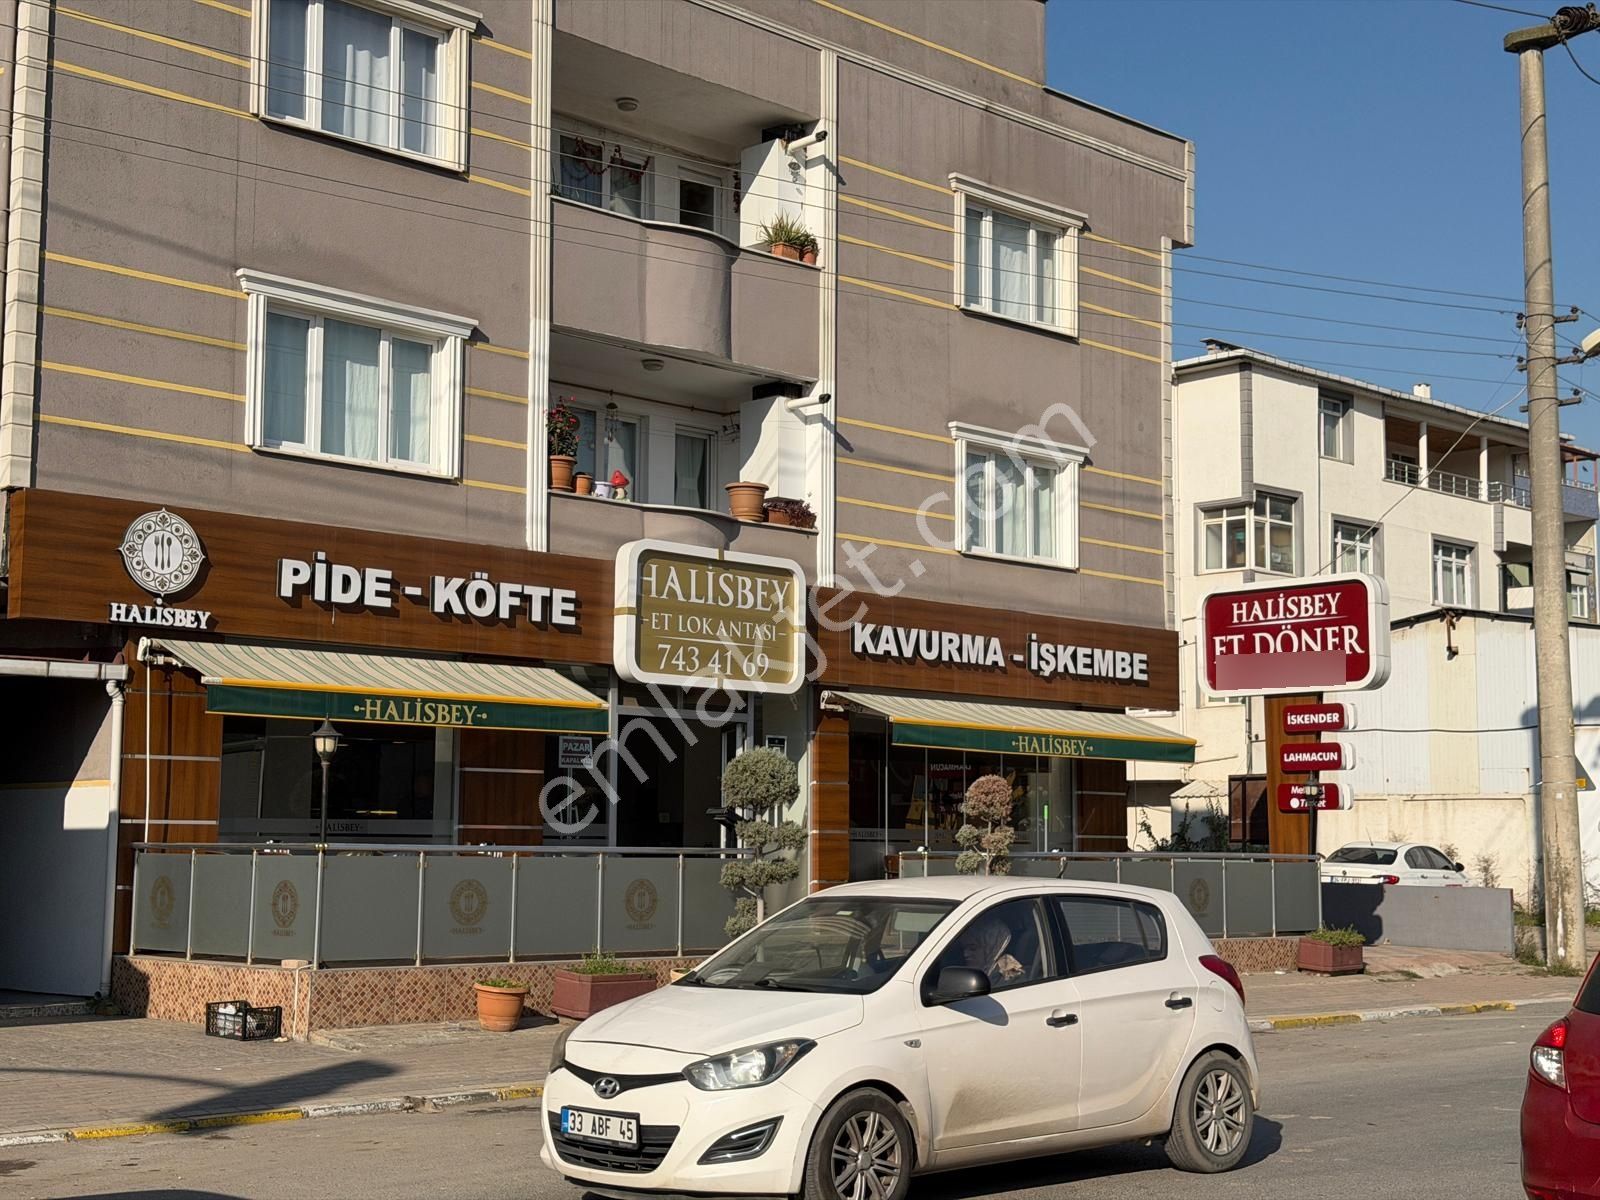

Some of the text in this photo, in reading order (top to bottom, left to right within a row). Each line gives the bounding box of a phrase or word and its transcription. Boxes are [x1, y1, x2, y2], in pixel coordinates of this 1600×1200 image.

[279, 551, 393, 608] PİDE
[431, 572, 577, 626] KÖFTE
[639, 563, 791, 614] HALİSBEY
[110, 597, 212, 630] HALİSBEY
[1232, 592, 1342, 624] HALİSBEY
[658, 643, 769, 678] 743 41 69
[854, 622, 1006, 668] KAVURMA
[1029, 633, 1148, 681] İŞKEMBE
[1287, 712, 1340, 725] İSKENDER
[563, 742, 590, 752] PAZAR
[1283, 751, 1338, 762] LAHMACUN
[569, 1112, 634, 1140] 33 ABF 45
